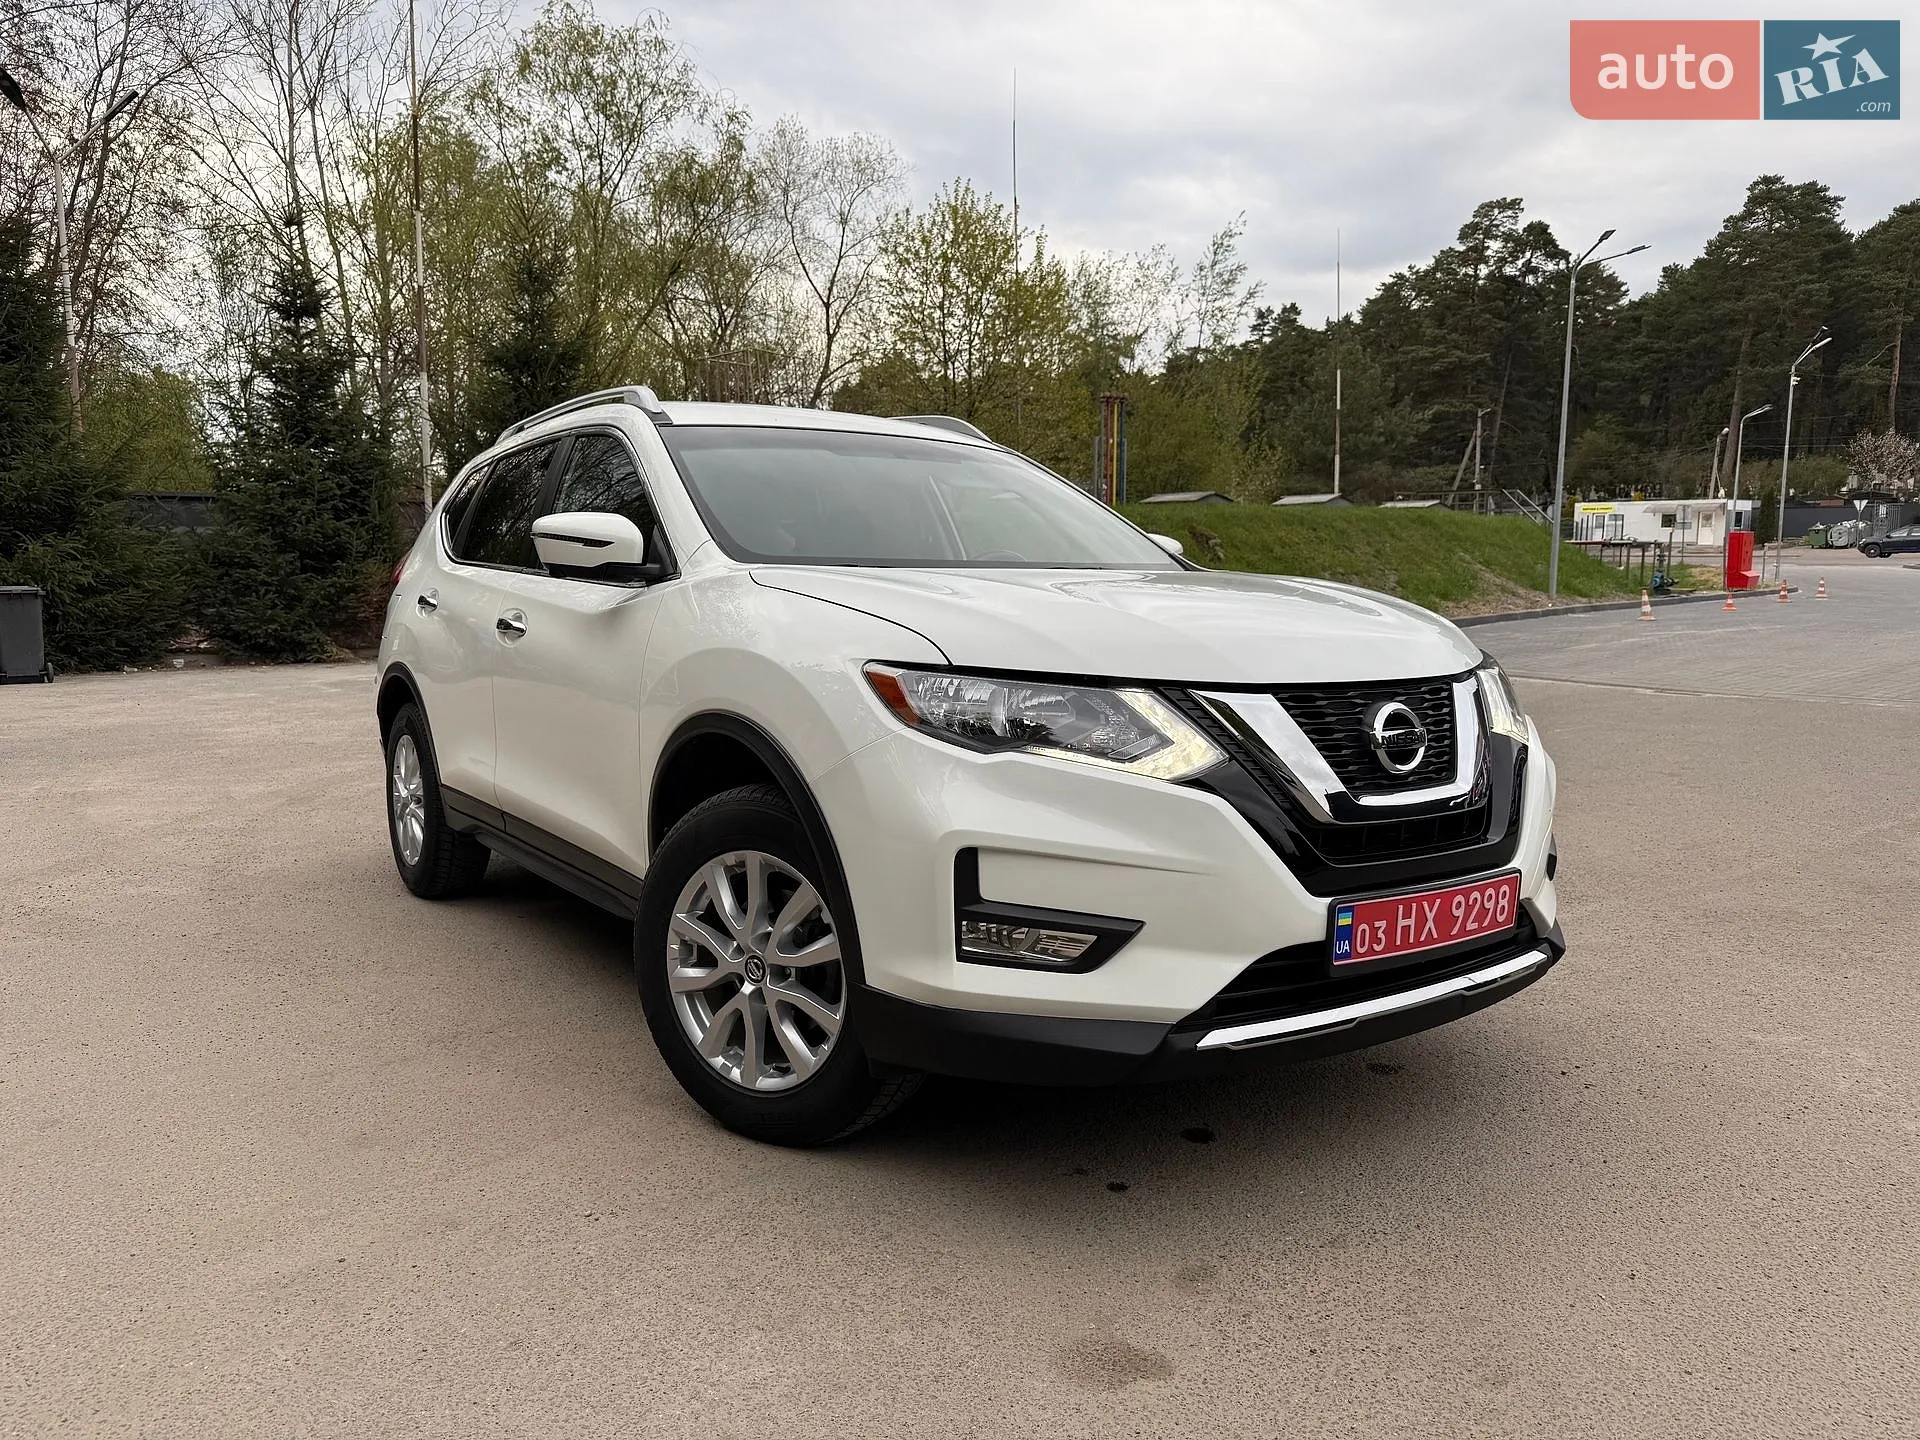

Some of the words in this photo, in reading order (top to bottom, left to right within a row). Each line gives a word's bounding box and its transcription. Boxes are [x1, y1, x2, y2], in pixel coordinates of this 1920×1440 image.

[1355, 920, 1387, 954] 03
[1395, 898, 1441, 946] HX
[1450, 884, 1510, 936] 9298
[1336, 940, 1350, 954] UA
